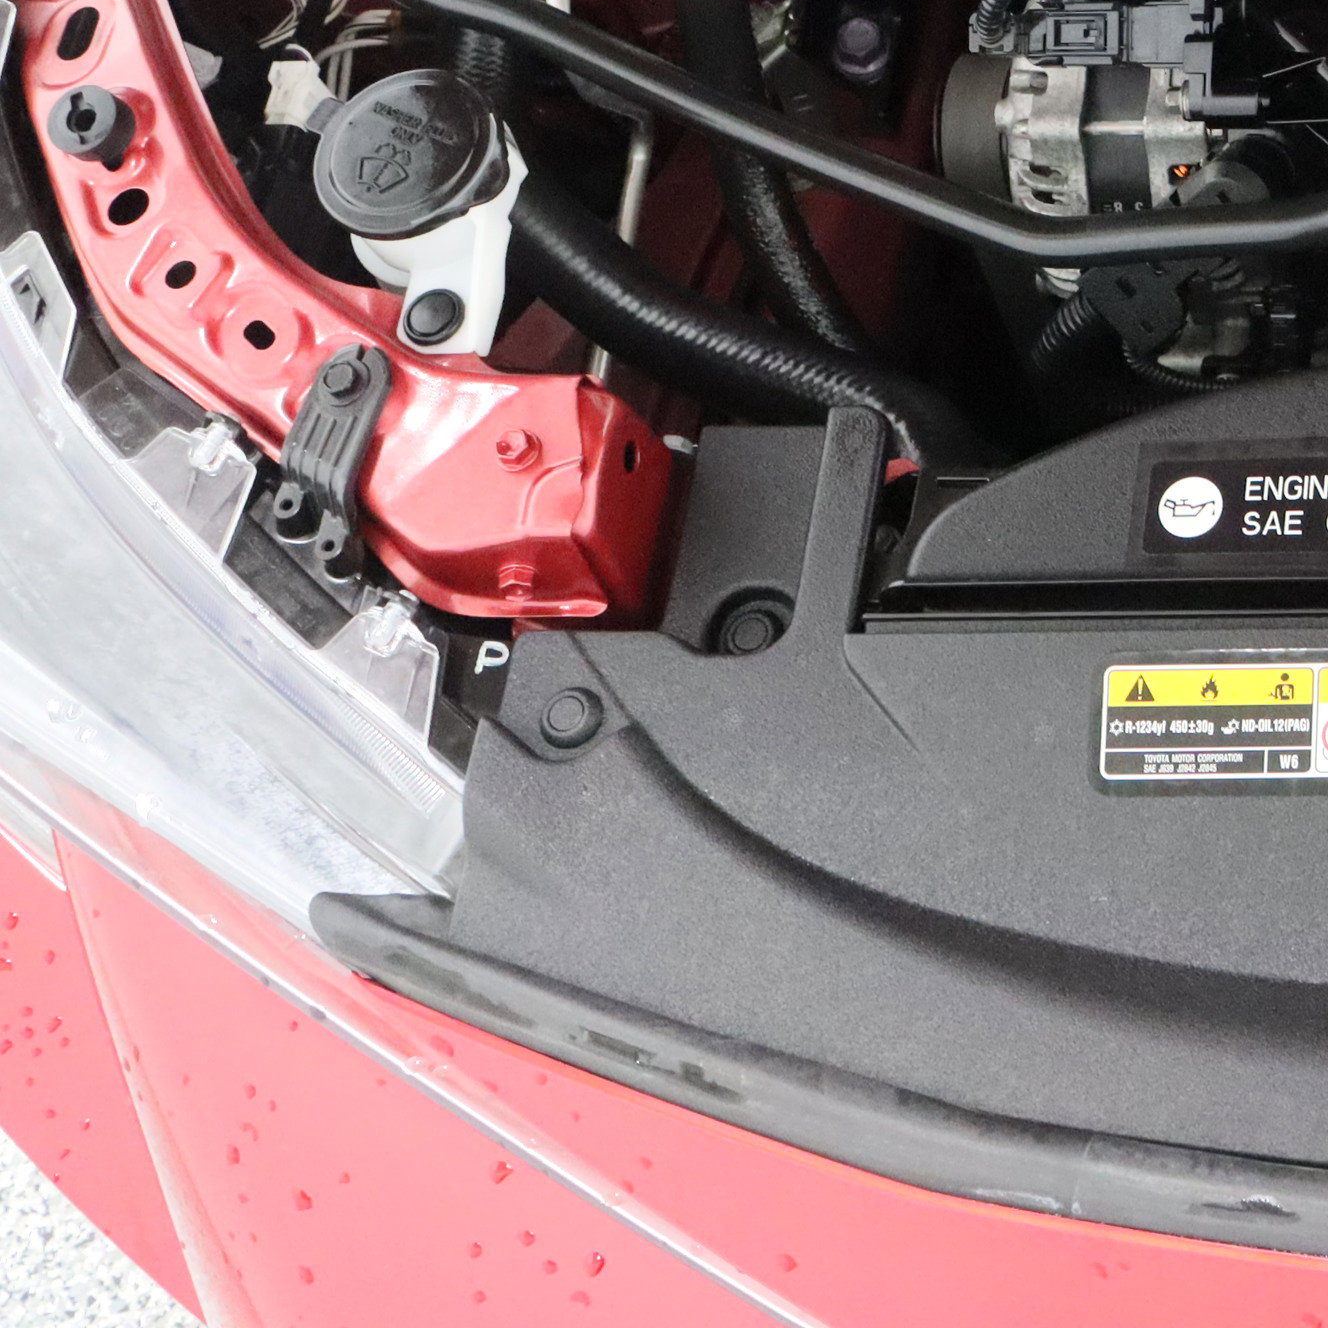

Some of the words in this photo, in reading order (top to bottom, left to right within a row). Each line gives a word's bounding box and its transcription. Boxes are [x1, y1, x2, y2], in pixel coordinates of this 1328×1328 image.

[1241, 510, 1304, 536] SAE
[1125, 719, 1166, 737] R-1234yf
[1170, 719, 1214, 736] 450±30g
[1144, 754, 1170, 763] TOYOTA
[1171, 754, 1195, 763] MOTOR
[1197, 753, 1243, 763] CORPORATION
[1279, 754, 1299, 769] W6
[1143, 764, 1157, 773] SAE
